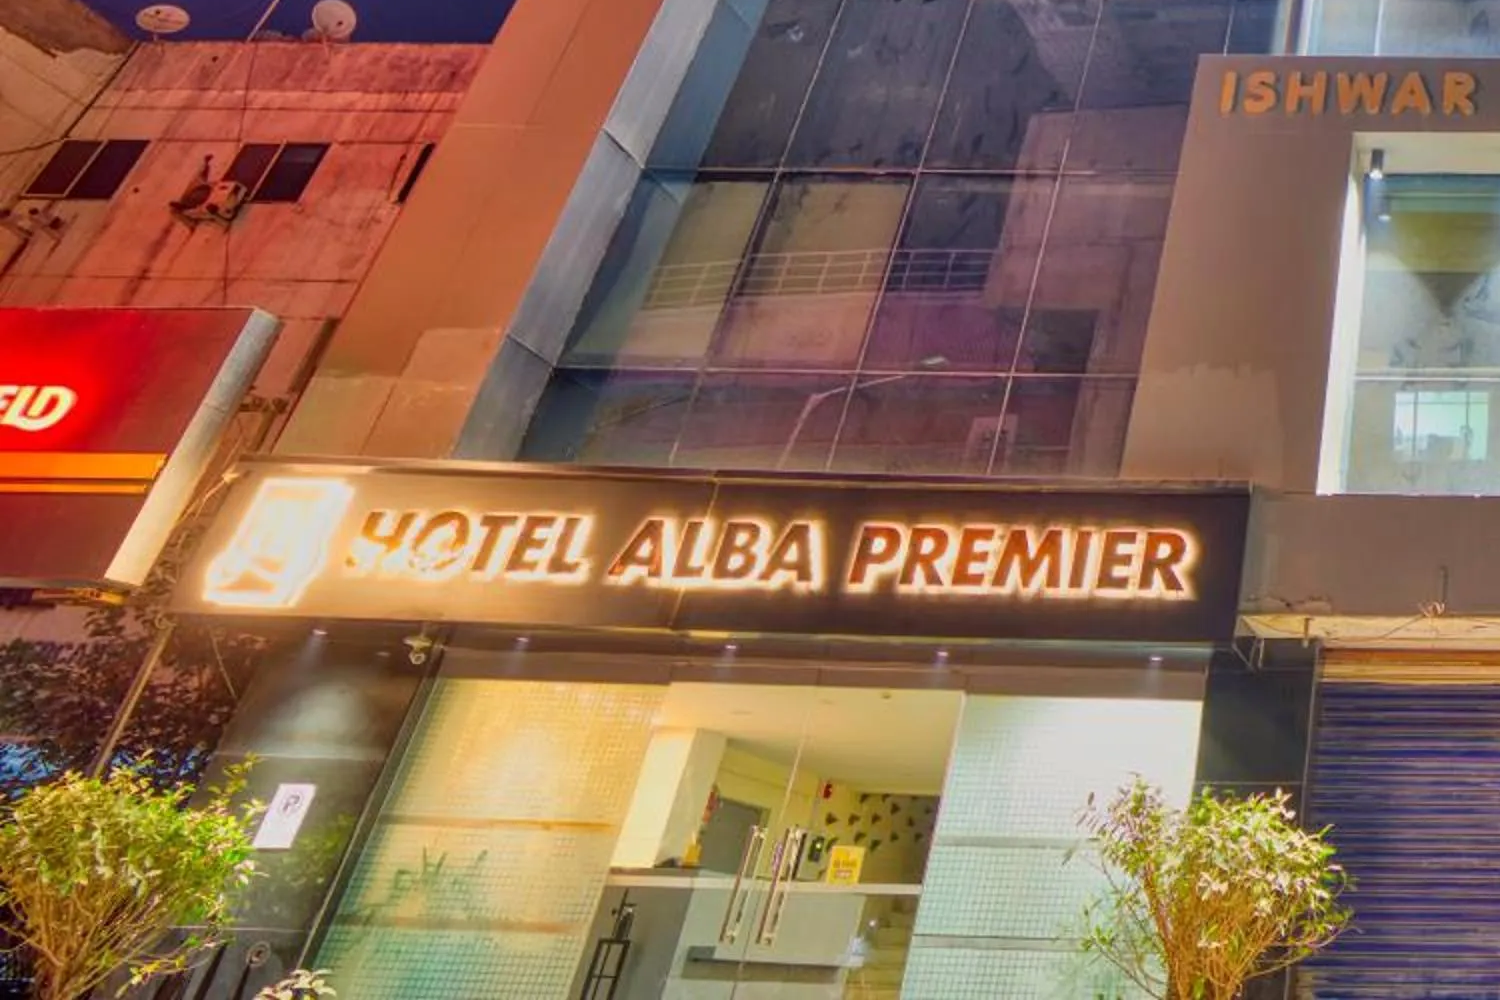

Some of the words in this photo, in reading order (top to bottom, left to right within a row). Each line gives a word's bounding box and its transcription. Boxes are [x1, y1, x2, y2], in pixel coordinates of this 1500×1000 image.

[1220, 71, 1476, 117] ISHWAR
[343, 508, 592, 578] HOTEL
[606, 517, 822, 588] ALBA
[845, 523, 1194, 598] PREMIER
